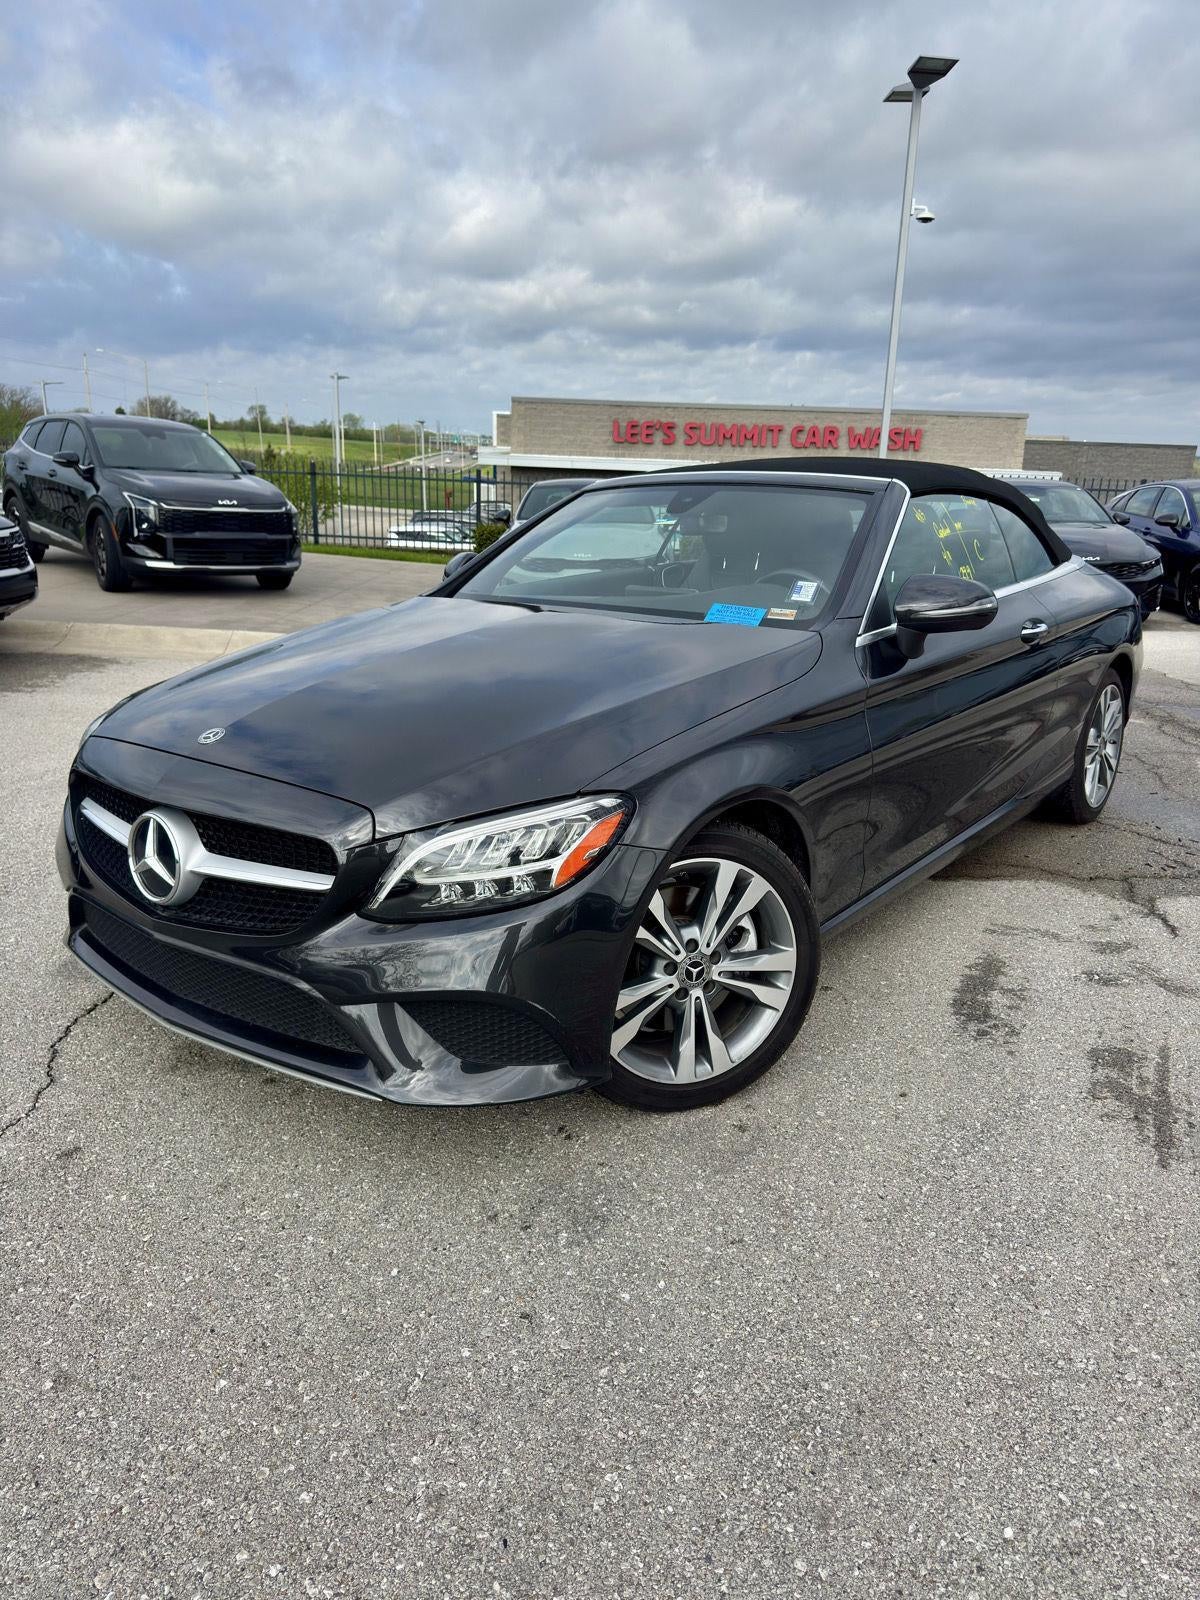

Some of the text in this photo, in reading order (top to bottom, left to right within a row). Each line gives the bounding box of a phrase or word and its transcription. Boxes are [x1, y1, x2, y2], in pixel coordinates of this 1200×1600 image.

[612, 418, 676, 445] LEE'S
[683, 422, 784, 448] SUMMIT
[790, 424, 840, 449] CAR
